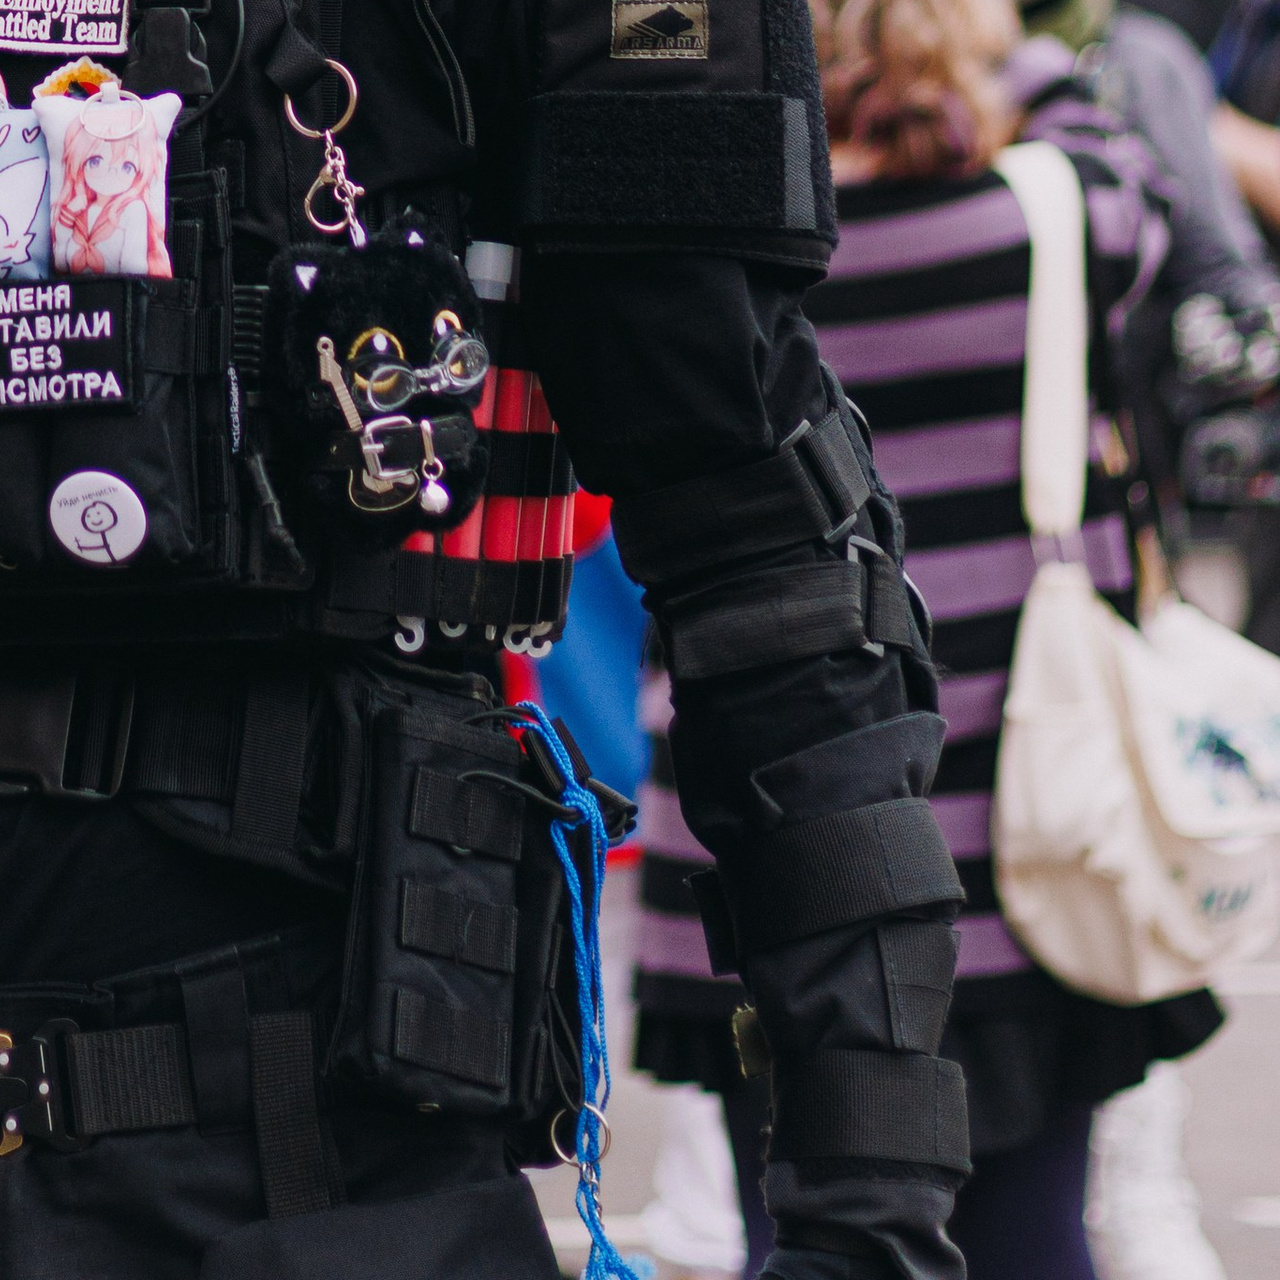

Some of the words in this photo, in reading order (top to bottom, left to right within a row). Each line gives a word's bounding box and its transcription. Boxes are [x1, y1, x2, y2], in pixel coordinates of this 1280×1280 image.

[60, 13, 118, 43] Team
[10, 344, 62, 372] БЕЗ
[231, 413, 241, 454] Tactical
